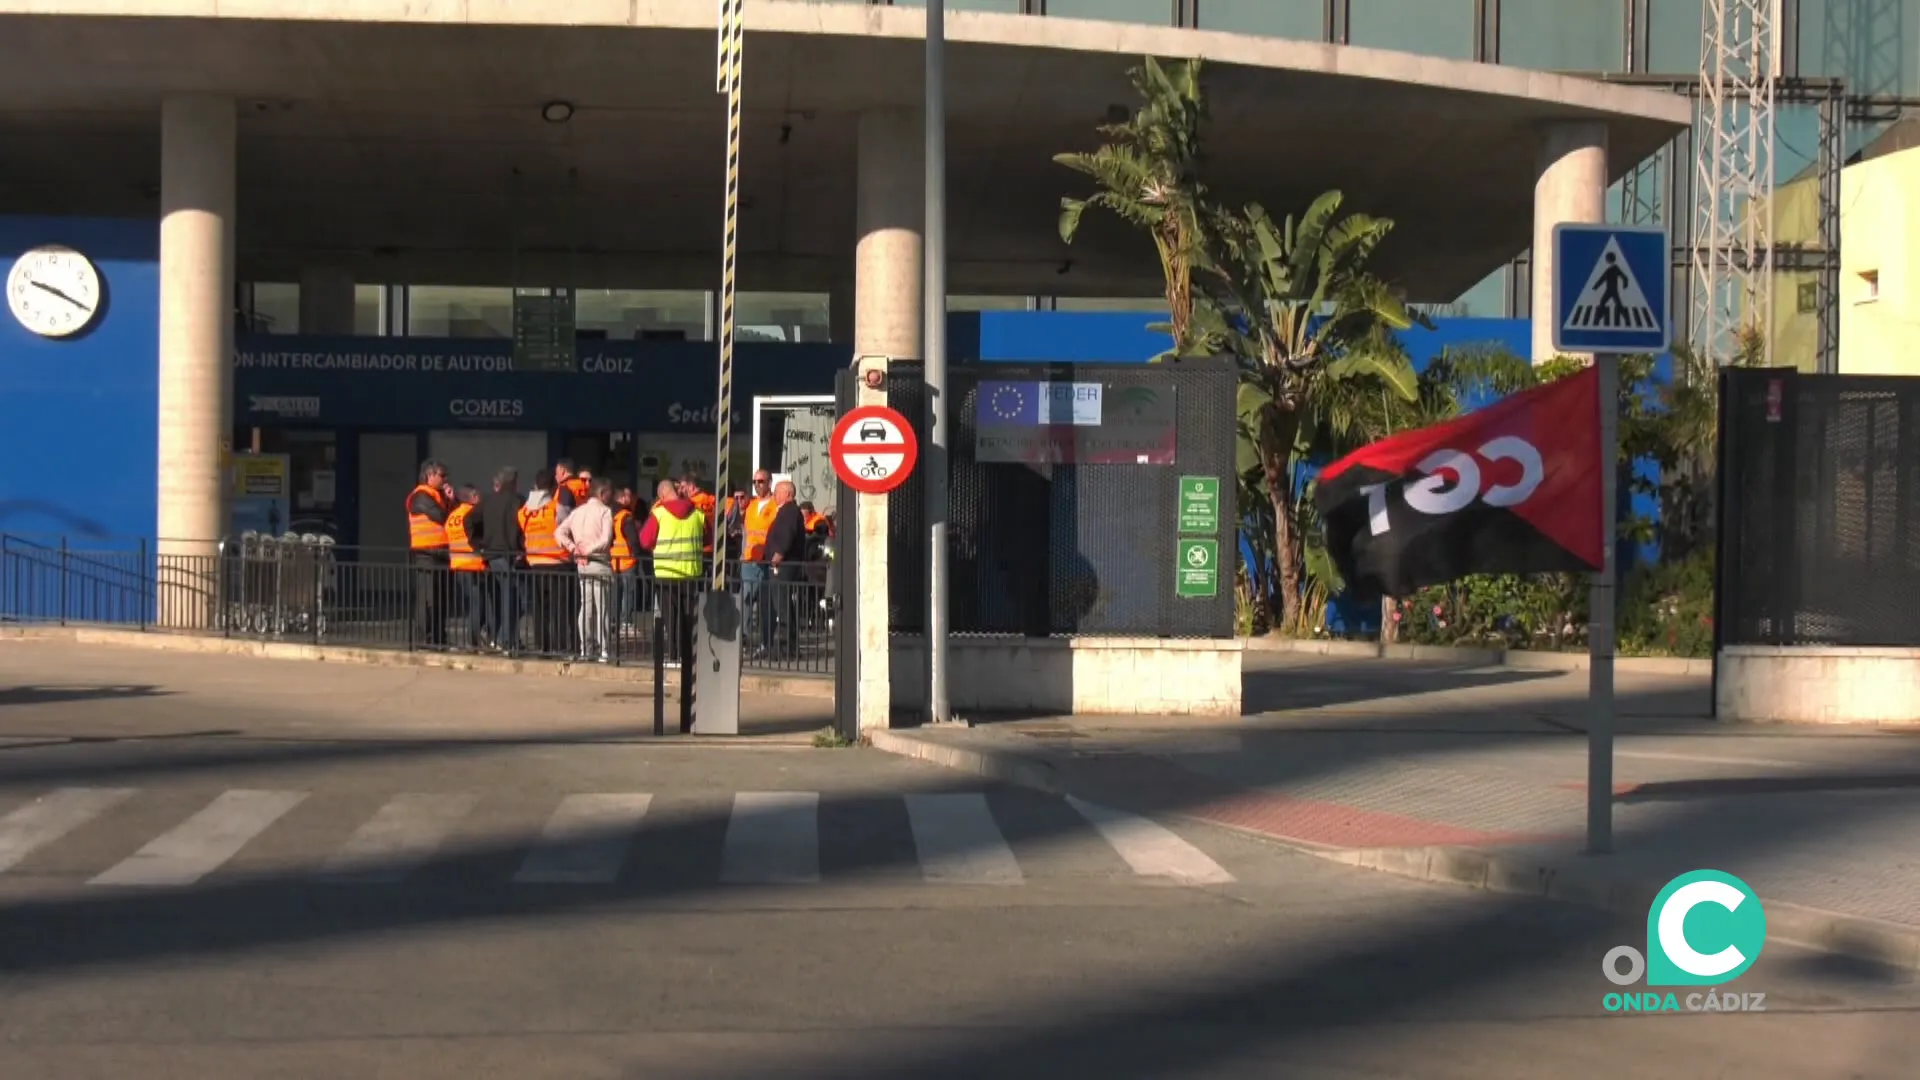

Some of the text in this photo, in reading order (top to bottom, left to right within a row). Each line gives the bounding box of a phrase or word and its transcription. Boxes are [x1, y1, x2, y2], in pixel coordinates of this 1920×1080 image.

[421, 355, 445, 370] DE
[582, 353, 634, 374] CÁDIZ
[449, 399, 524, 417] COMES
